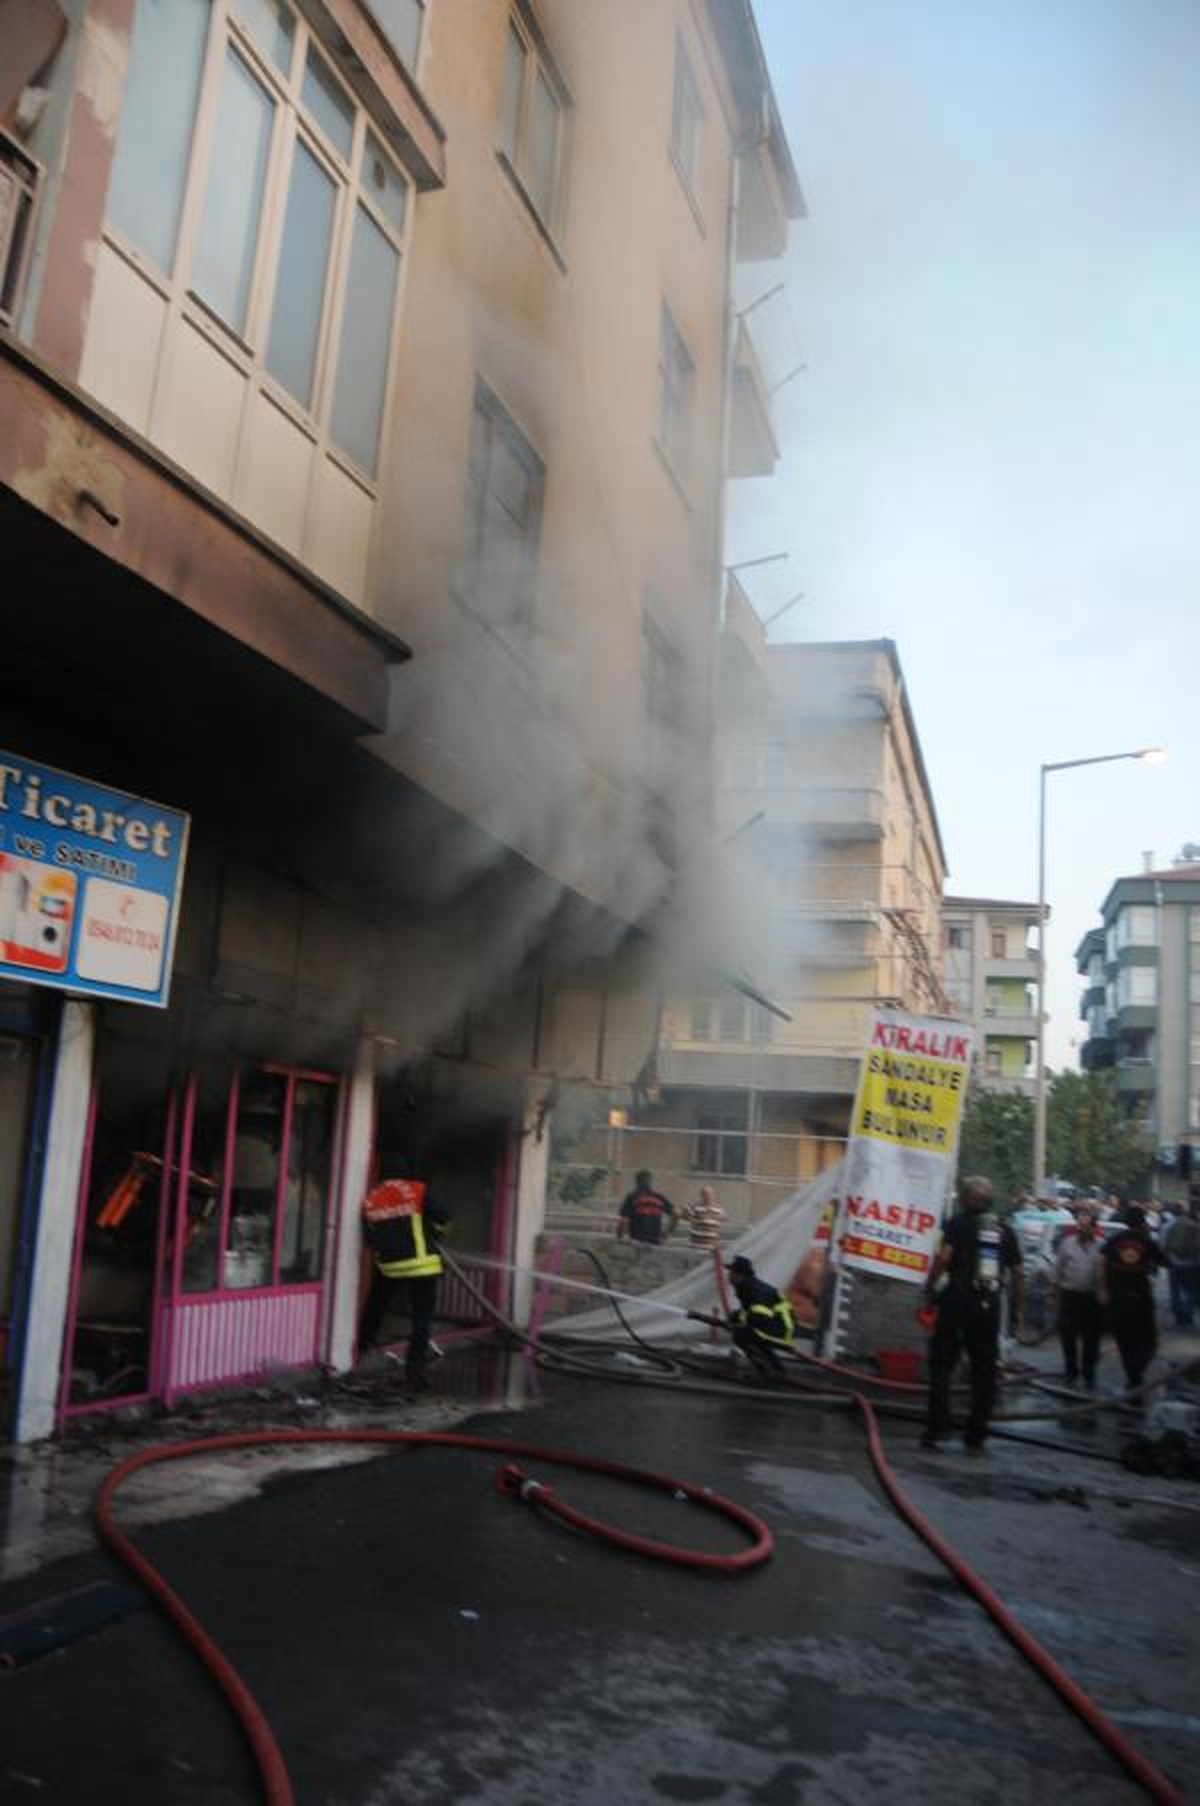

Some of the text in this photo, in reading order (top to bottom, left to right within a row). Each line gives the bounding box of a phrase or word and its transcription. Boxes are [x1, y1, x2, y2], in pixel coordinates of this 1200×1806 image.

[0, 765, 171, 857] Ticaret
[869, 1055, 961, 1091] SANDALYE
[885, 1087, 933, 1113] MASA
[863, 1109, 947, 1146] BULUNUR
